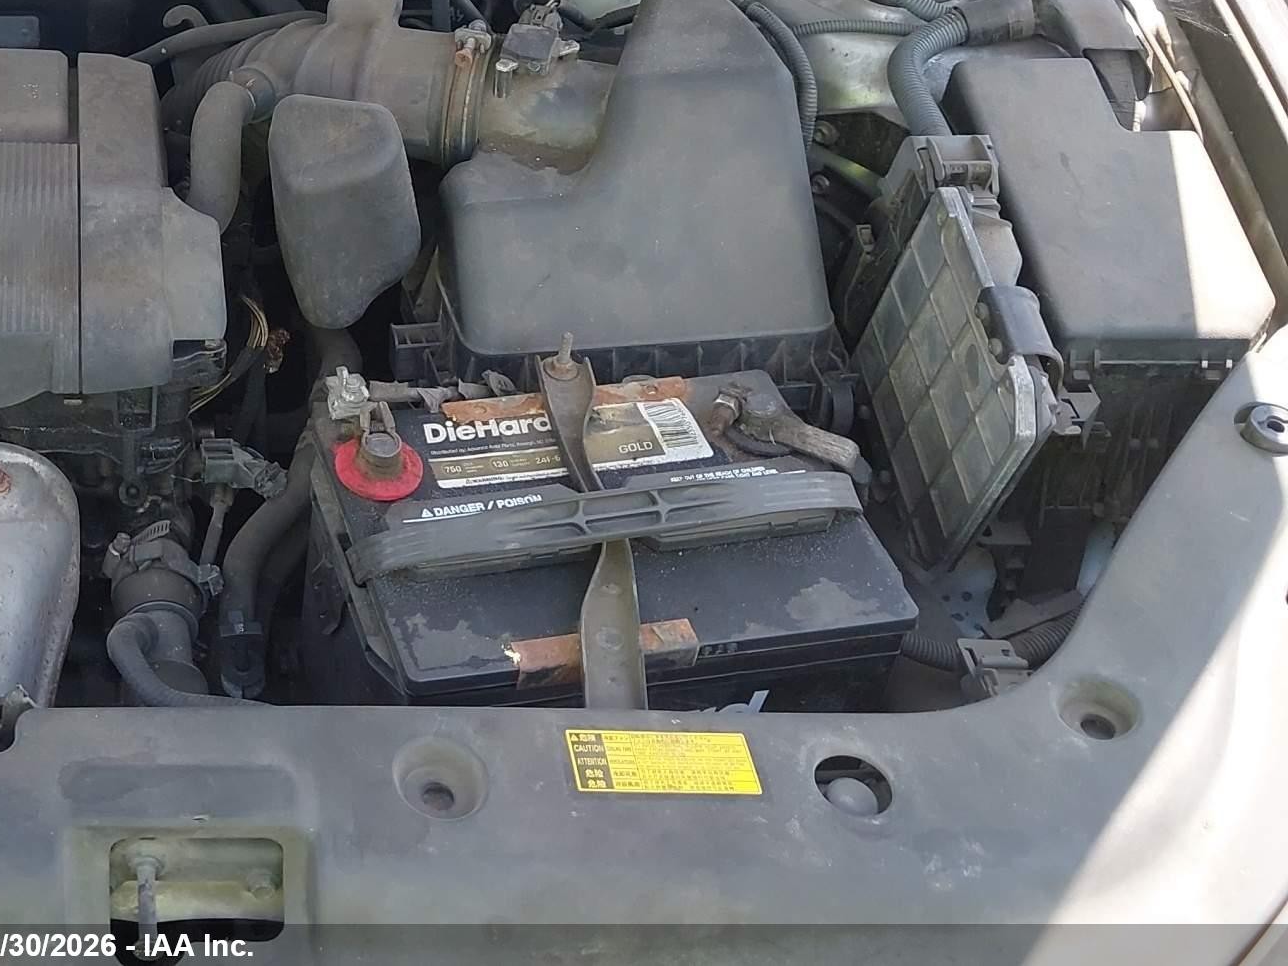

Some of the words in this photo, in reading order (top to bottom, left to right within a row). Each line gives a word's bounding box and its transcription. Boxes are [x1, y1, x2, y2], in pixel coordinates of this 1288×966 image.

[423, 414, 552, 444] DieHard
[618, 441, 653, 454] GOLD
[444, 465, 462, 474] 750
[492, 459, 509, 468] 130
[433, 502, 486, 517] DANGER
[487, 500, 495, 510] /
[497, 494, 543, 509] POISON
[577, 757, 608, 765] ATTENTION
